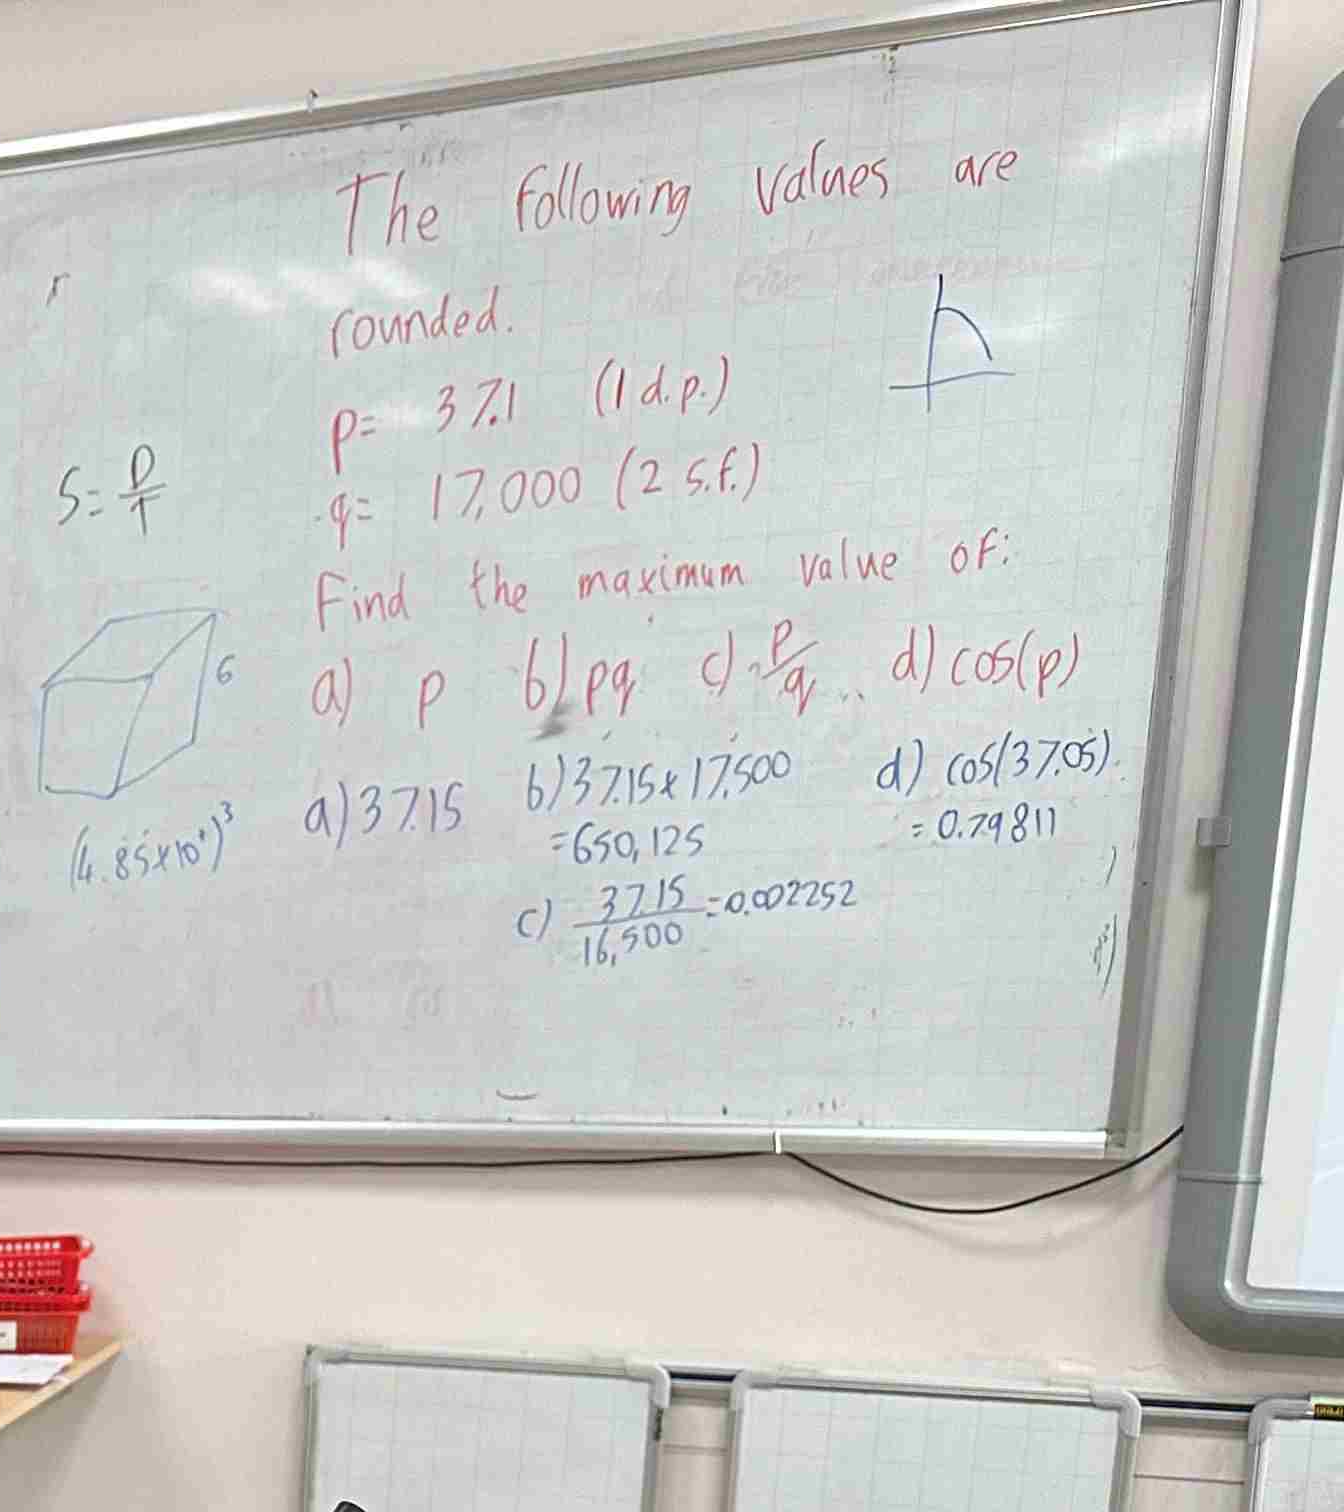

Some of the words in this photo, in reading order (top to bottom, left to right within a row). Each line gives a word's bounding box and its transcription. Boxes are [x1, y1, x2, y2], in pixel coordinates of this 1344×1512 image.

[335, 169, 441, 257] The
[515, 162, 691, 238] following
[954, 147, 1020, 187] are
[330, 284, 515, 359] rounded.
[436, 377, 517, 434] 37.1
[431, 465, 583, 523] 17,000
[315, 573, 410, 634] Find
[470, 561, 529, 615] the
[577, 559, 752, 608] maximum
[798, 533, 899, 586] value
[311, 659, 356, 730] a)
[522, 631, 569, 714] b)
[700, 629, 736, 697] c)
[890, 623, 937, 695] d)
[950, 628, 1080, 699] cos(p)
[875, 738, 924, 798] d)
[516, 898, 554, 943] c)
